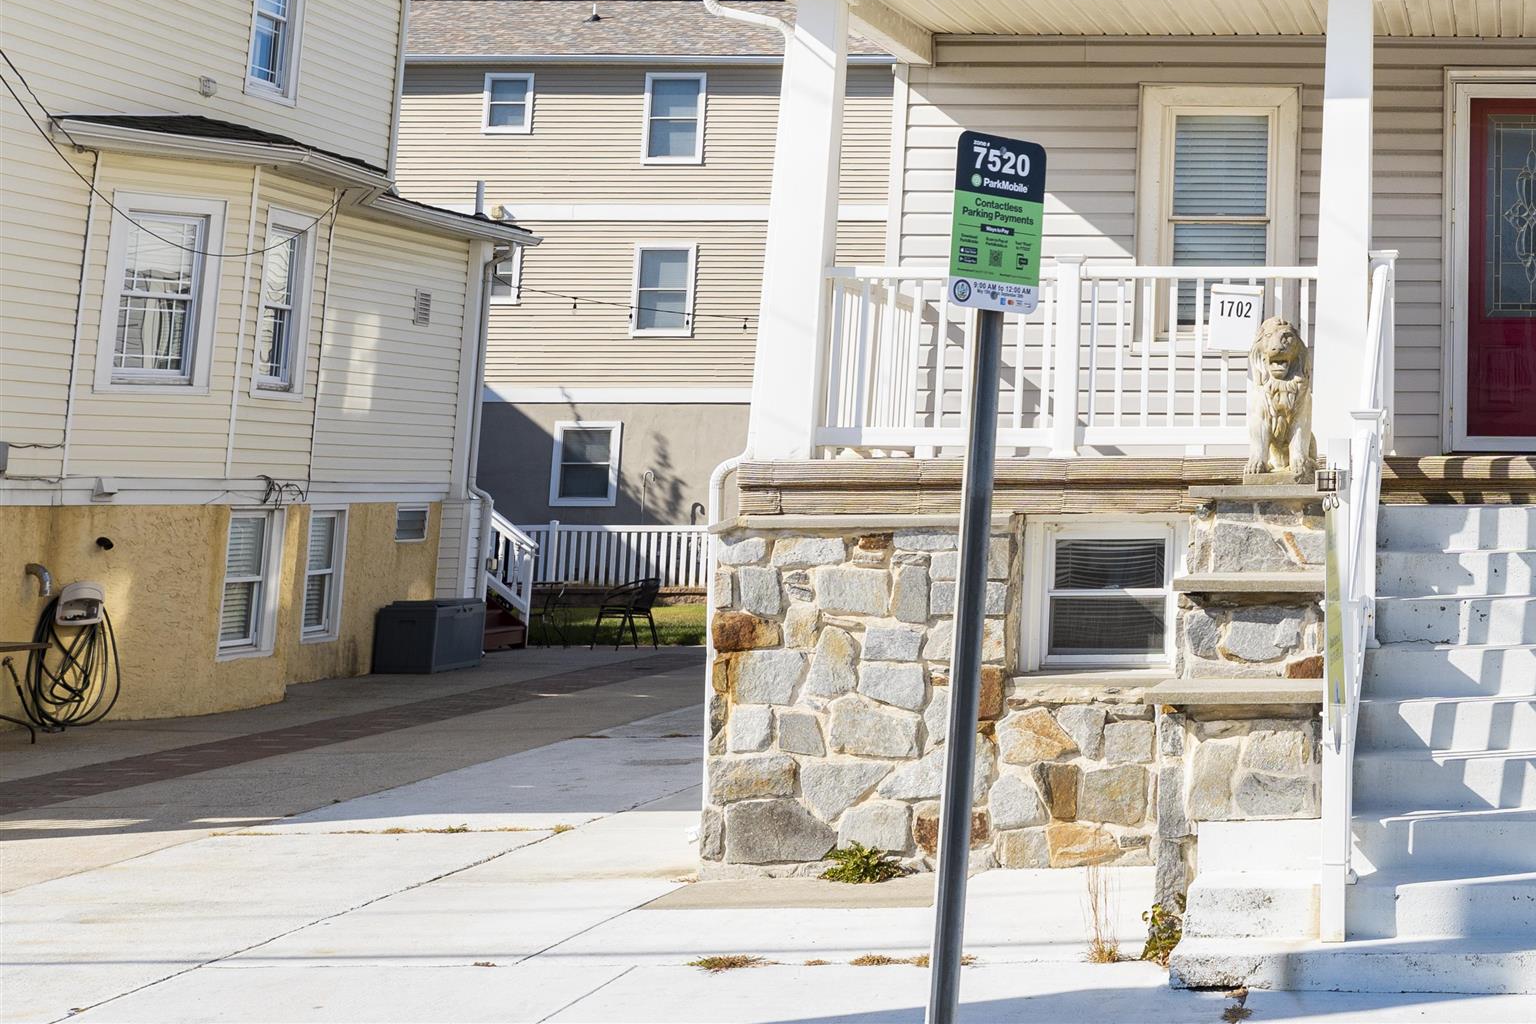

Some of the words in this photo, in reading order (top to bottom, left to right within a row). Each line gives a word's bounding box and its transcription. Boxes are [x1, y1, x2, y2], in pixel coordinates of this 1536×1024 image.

[973, 146, 1030, 177] 7520
[983, 177, 1029, 193] ParkMobile
[975, 197, 1023, 213] Contactless
[962, 206, 994, 221] Parking
[994, 211, 1034, 225] Payments
[987, 283, 997, 291] AM
[997, 284, 1005, 292] to
[1021, 287, 1032, 295] AM
[1220, 300, 1253, 318] 1702
